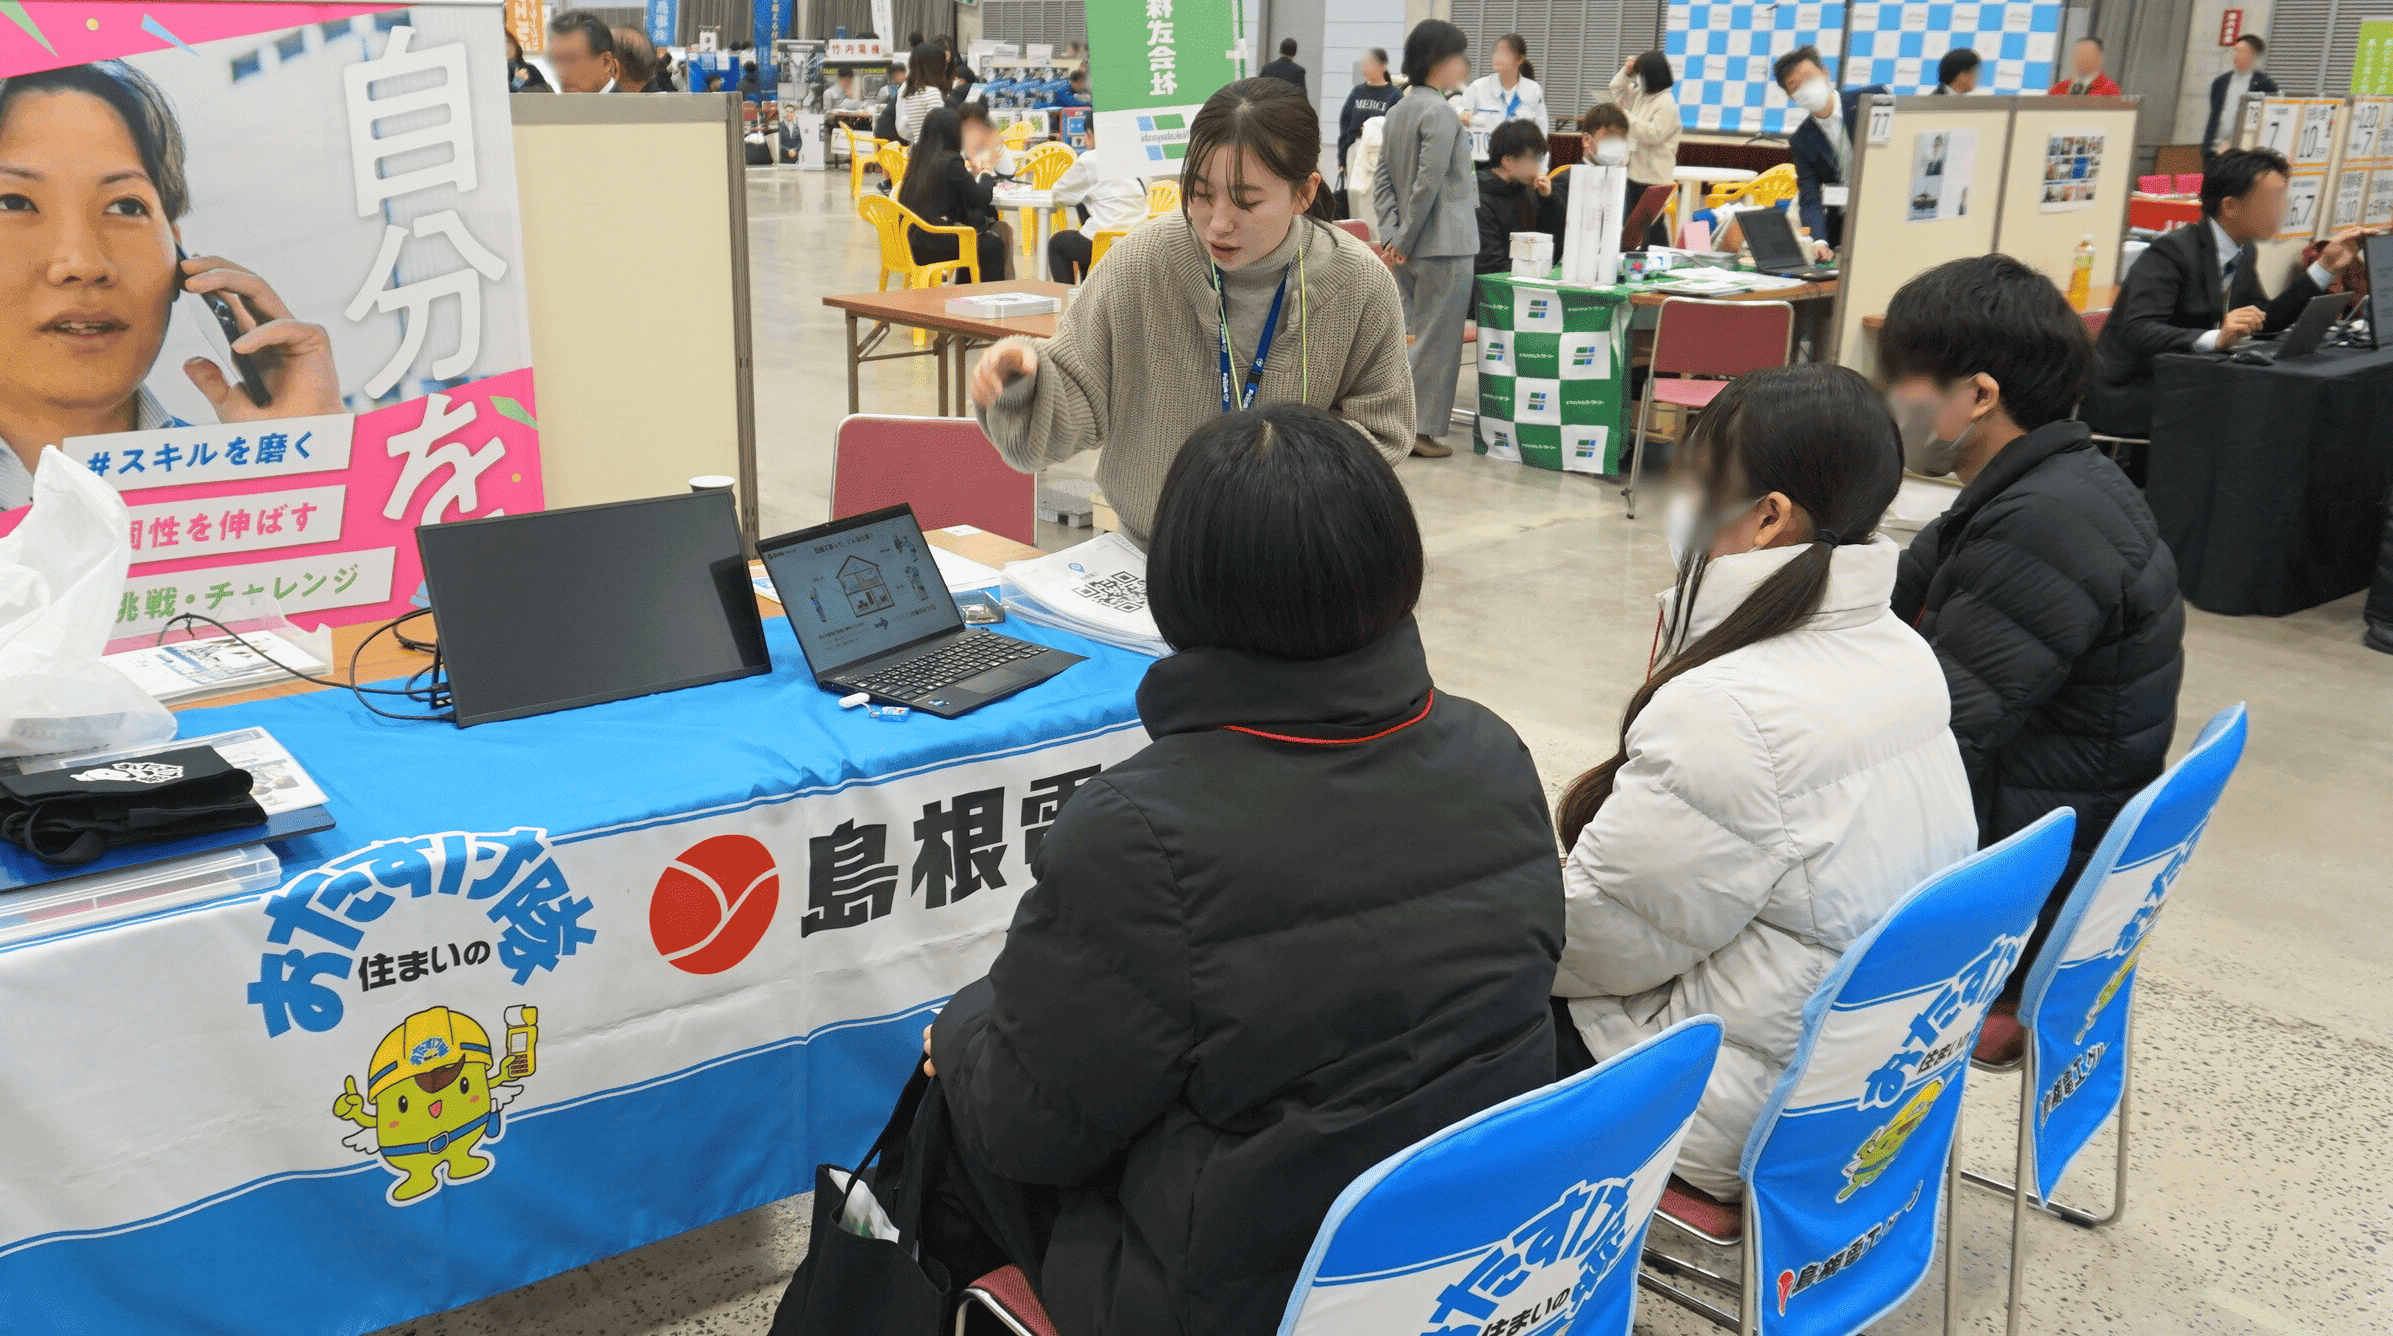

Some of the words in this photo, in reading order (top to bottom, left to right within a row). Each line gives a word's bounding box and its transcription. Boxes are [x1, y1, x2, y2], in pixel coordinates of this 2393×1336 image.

[88, 431, 313, 478] #スキルを磨く
[247, 830, 597, 1040] おたすけ隊
[357, 940, 491, 993] 住まいの
[1420, 1178, 1634, 1336] たすけ隊
